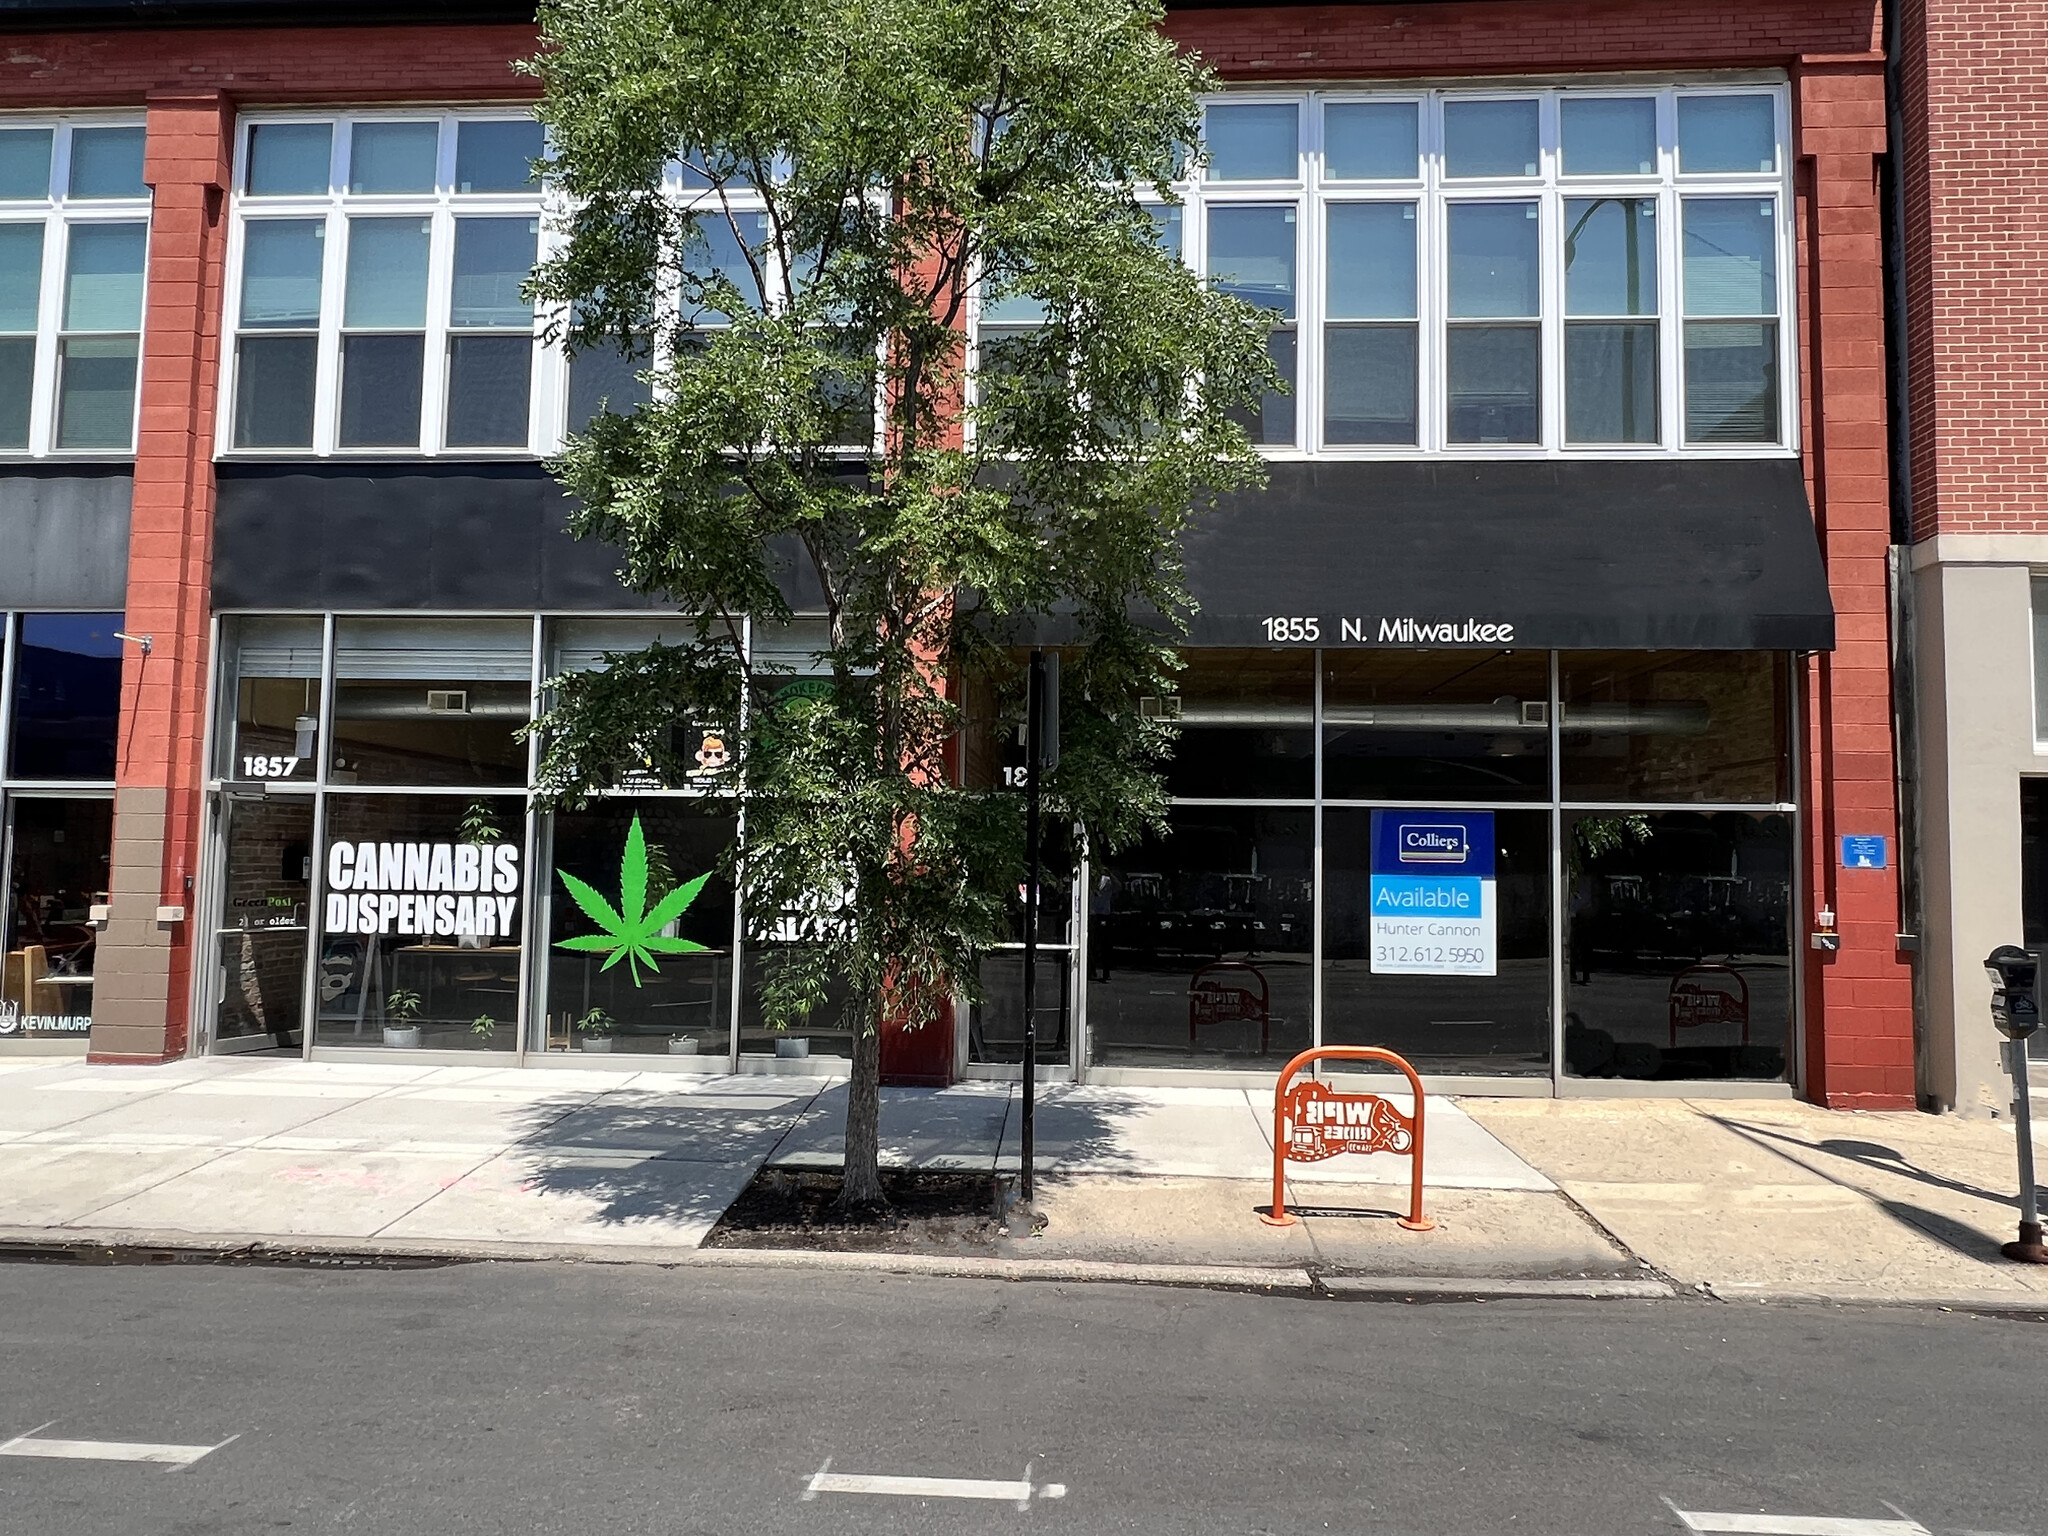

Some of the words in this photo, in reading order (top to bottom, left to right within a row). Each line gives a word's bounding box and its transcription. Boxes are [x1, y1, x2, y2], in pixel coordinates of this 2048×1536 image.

[1261, 616, 1321, 642] 1855
[1341, 617, 1368, 642] N.
[1378, 617, 1515, 643] Milwaukee
[243, 756, 299, 777] 1857
[1406, 832, 1459, 848] Colliers
[328, 841, 519, 893] CANNABIS
[1376, 886, 1470, 909] Available
[269, 916, 296, 926] older
[325, 893, 517, 937] DISPENSARY
[1376, 922, 1424, 936] Hunter
[1427, 922, 1481, 937] Cannon
[1376, 946, 1485, 963] 312.612.5950
